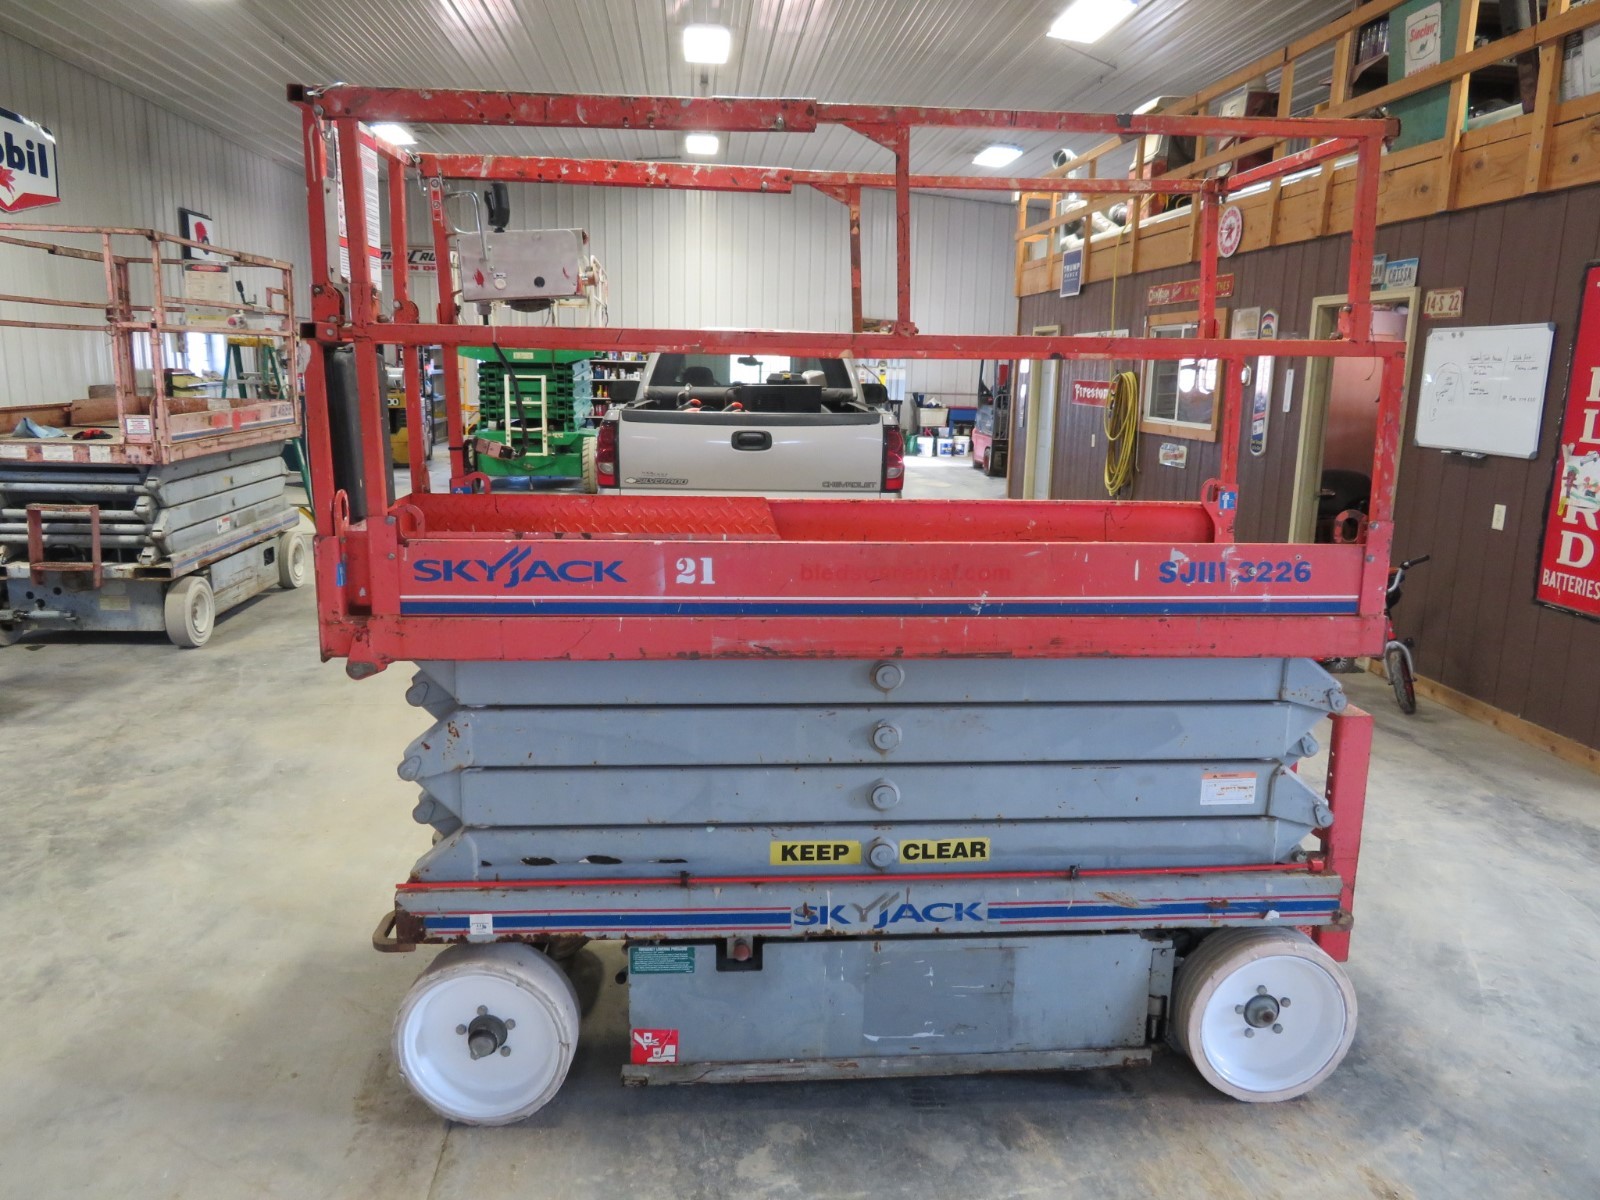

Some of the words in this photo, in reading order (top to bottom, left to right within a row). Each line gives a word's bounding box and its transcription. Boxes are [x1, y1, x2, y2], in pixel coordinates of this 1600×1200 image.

[0, 131, 48, 178] bil
[1064, 263, 1080, 272] TRUMP
[1448, 295, 1459, 311] 22
[1074, 383, 1109, 400] Fireston
[822, 481, 877, 489] CHEVROLET
[412, 545, 627, 589] SKYJACK
[675, 557, 716, 585] 21
[1238, 560, 1312, 583] 3226
[1542, 568, 1600, 600] BATTERIES
[781, 844, 850, 862] KEEP
[902, 841, 987, 860] CLEAR
[793, 892, 984, 929] SKYJACK
